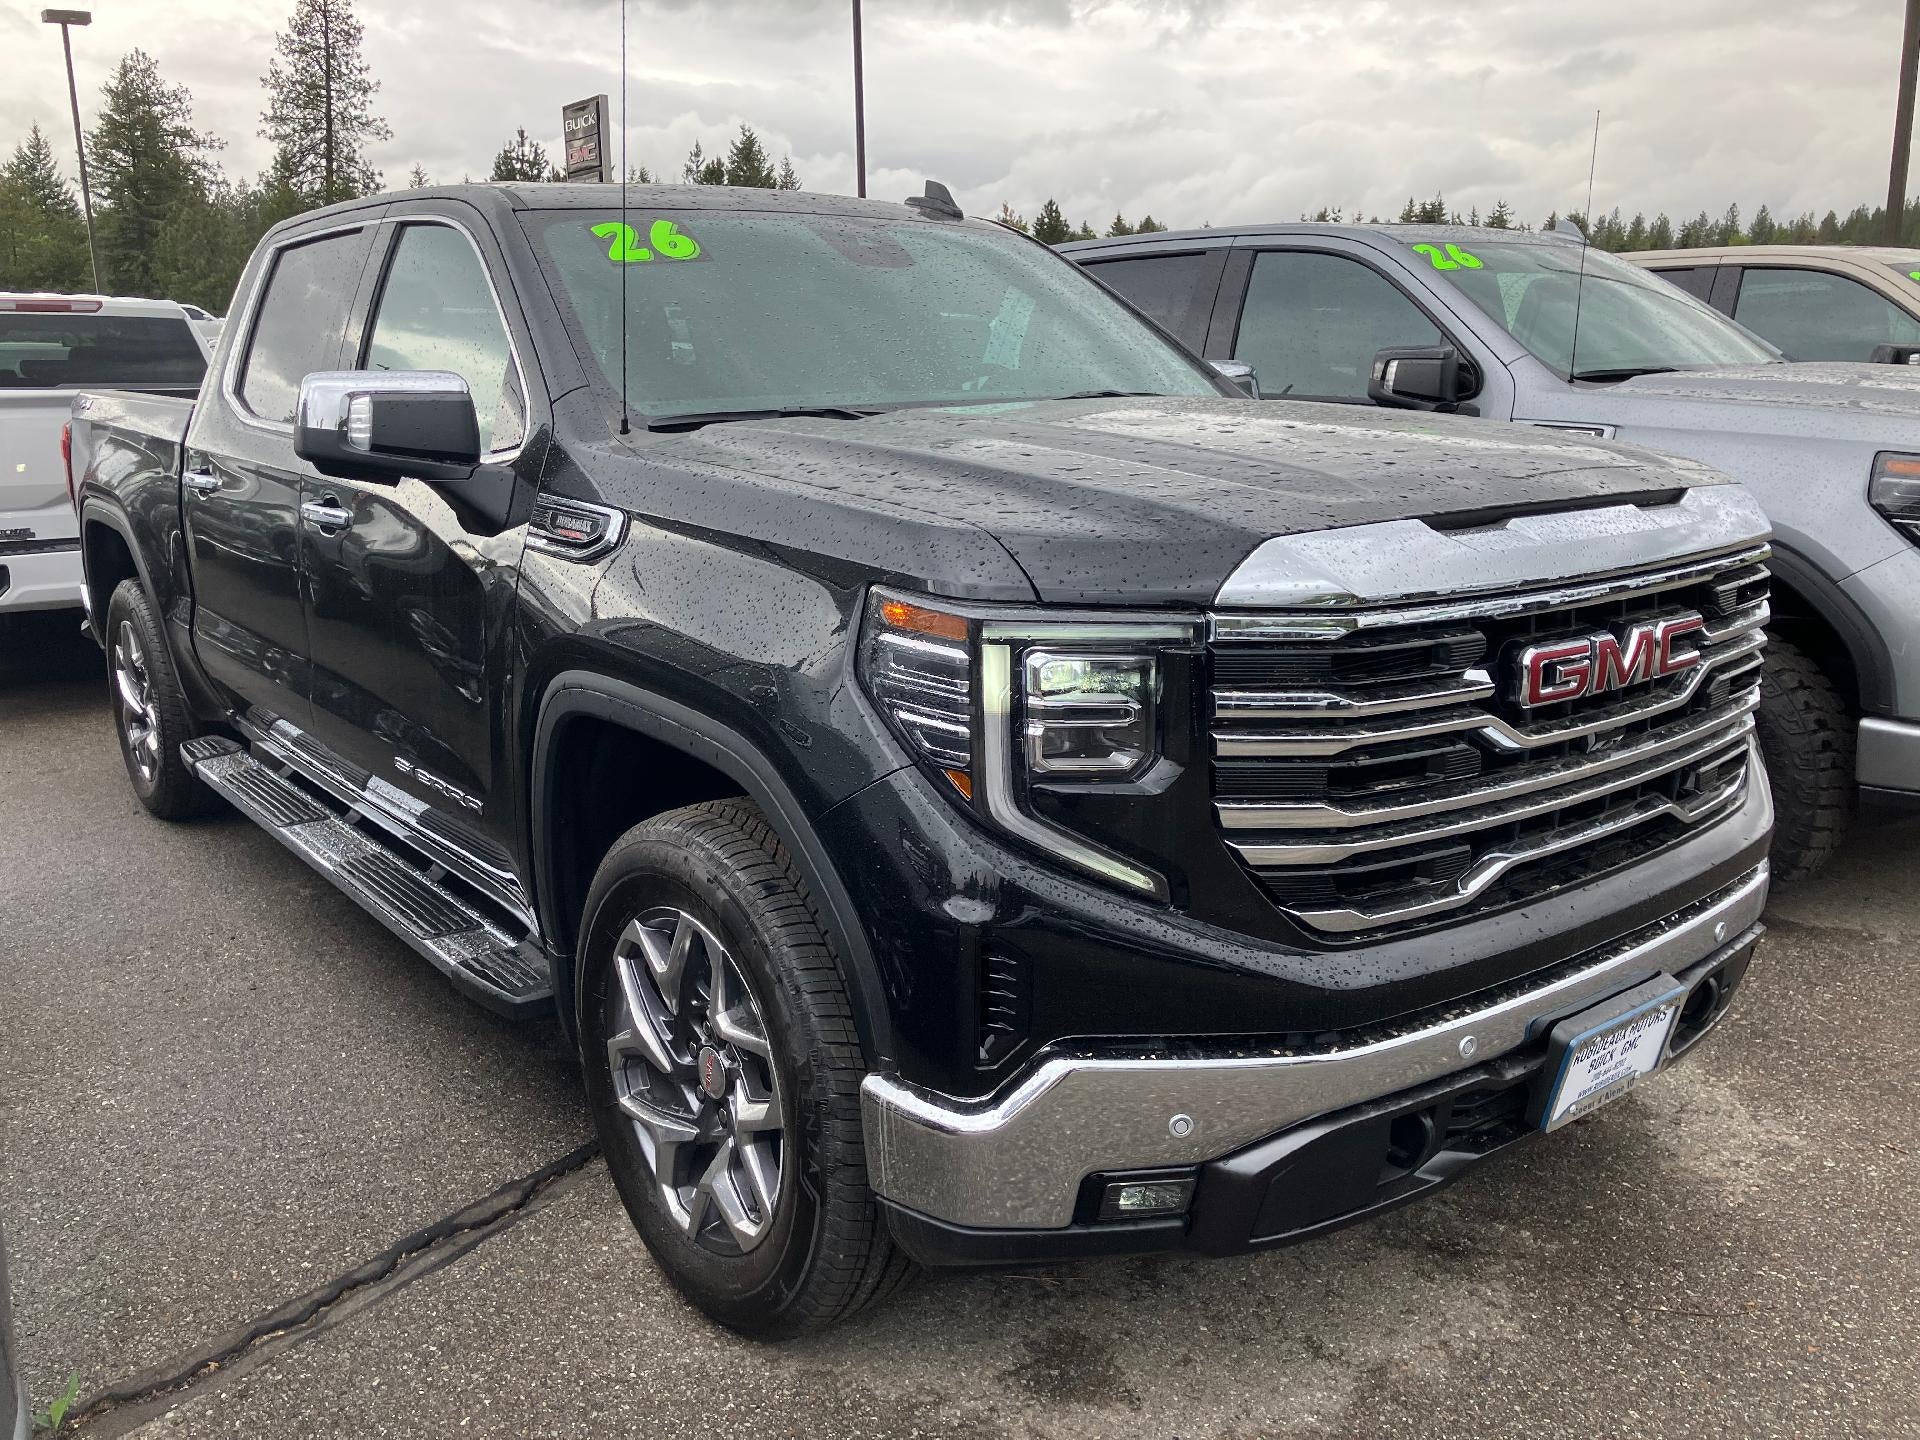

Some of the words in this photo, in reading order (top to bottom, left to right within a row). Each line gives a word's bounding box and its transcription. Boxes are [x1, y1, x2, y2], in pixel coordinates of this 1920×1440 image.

[565, 112, 596, 132] BUICK
[568, 142, 597, 166] GMC
[590, 220, 701, 262] 26
[1412, 243, 1484, 270] 26
[1520, 613, 1703, 709] GMC
[1629, 1011, 1667, 1038] MOTORS
[1587, 1047, 1616, 1073] BUICK
[1620, 1034, 1641, 1056] GMC
